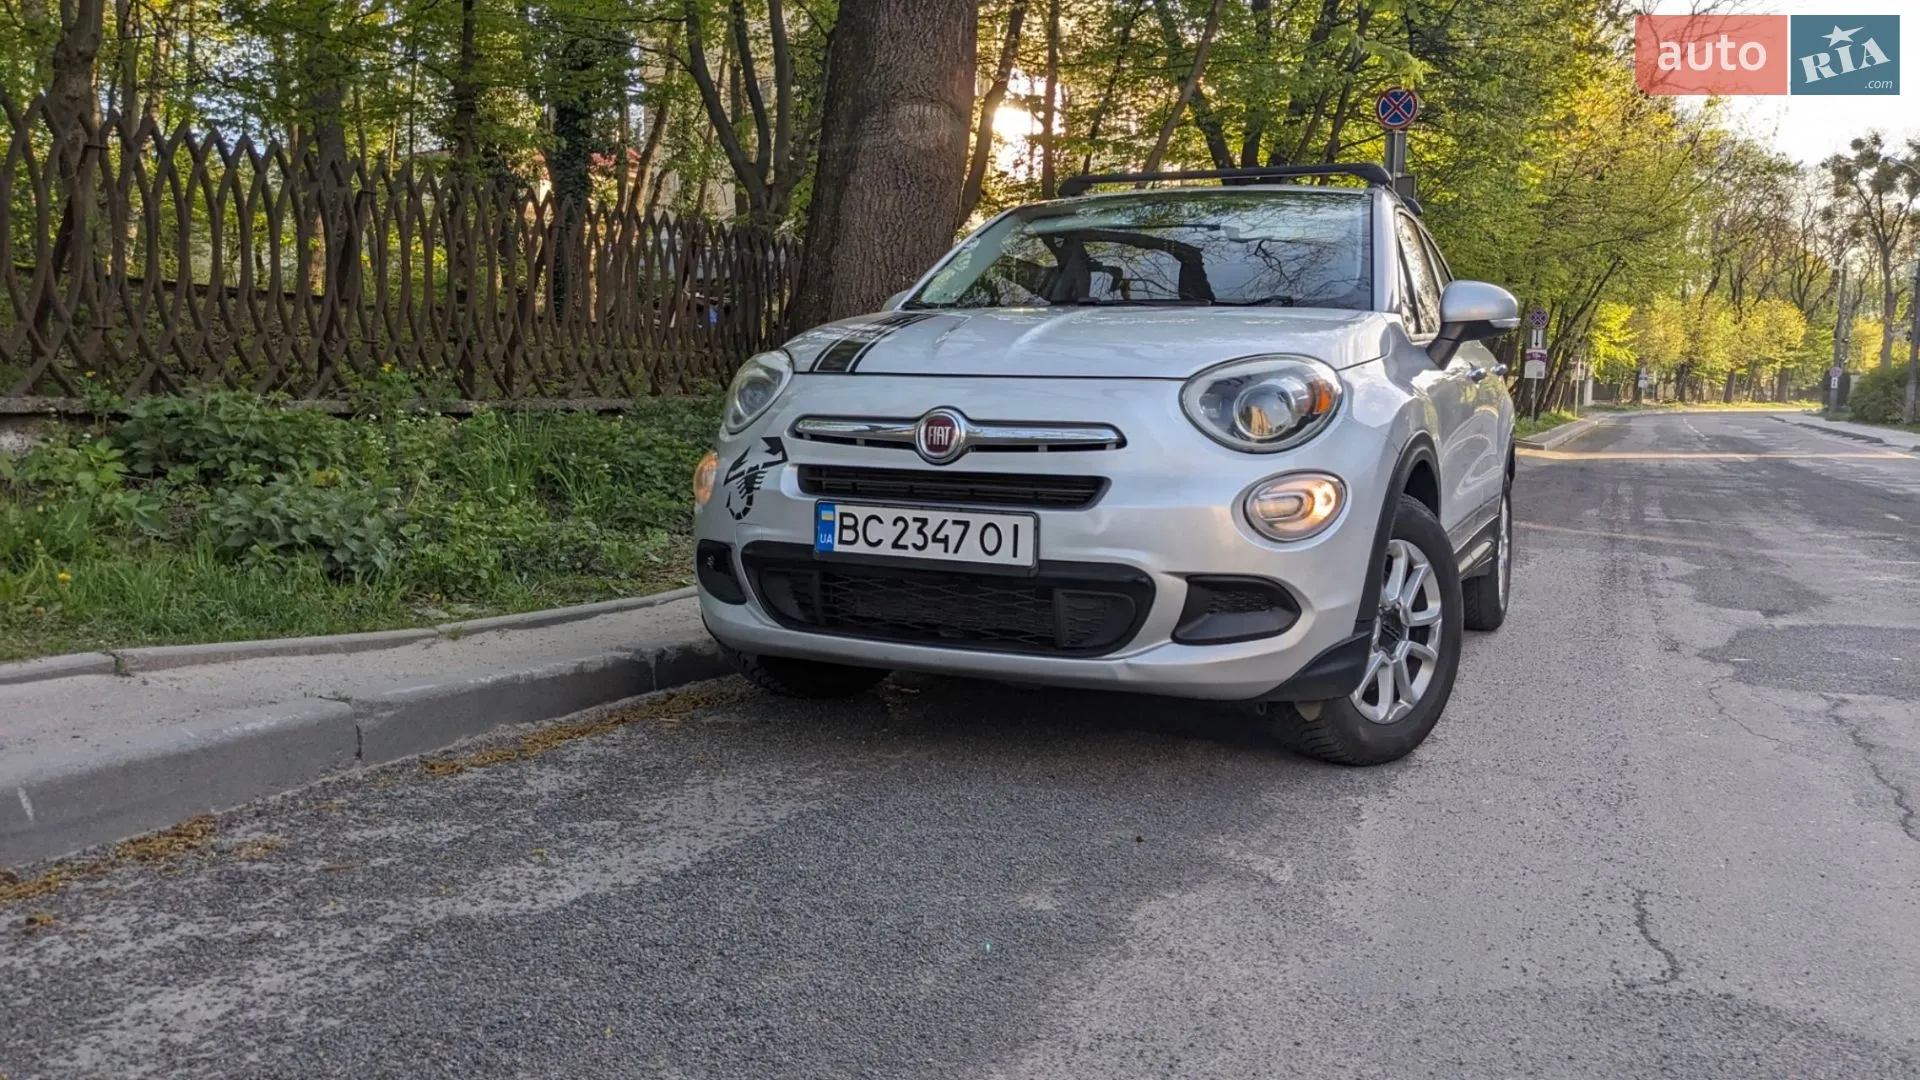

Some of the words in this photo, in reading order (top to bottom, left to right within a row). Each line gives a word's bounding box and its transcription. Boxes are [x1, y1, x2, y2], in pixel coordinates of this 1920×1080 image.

[927, 426, 952, 446] FIAT
[820, 533, 833, 545] UA
[837, 512, 884, 548] BC
[891, 516, 970, 554] 2347
